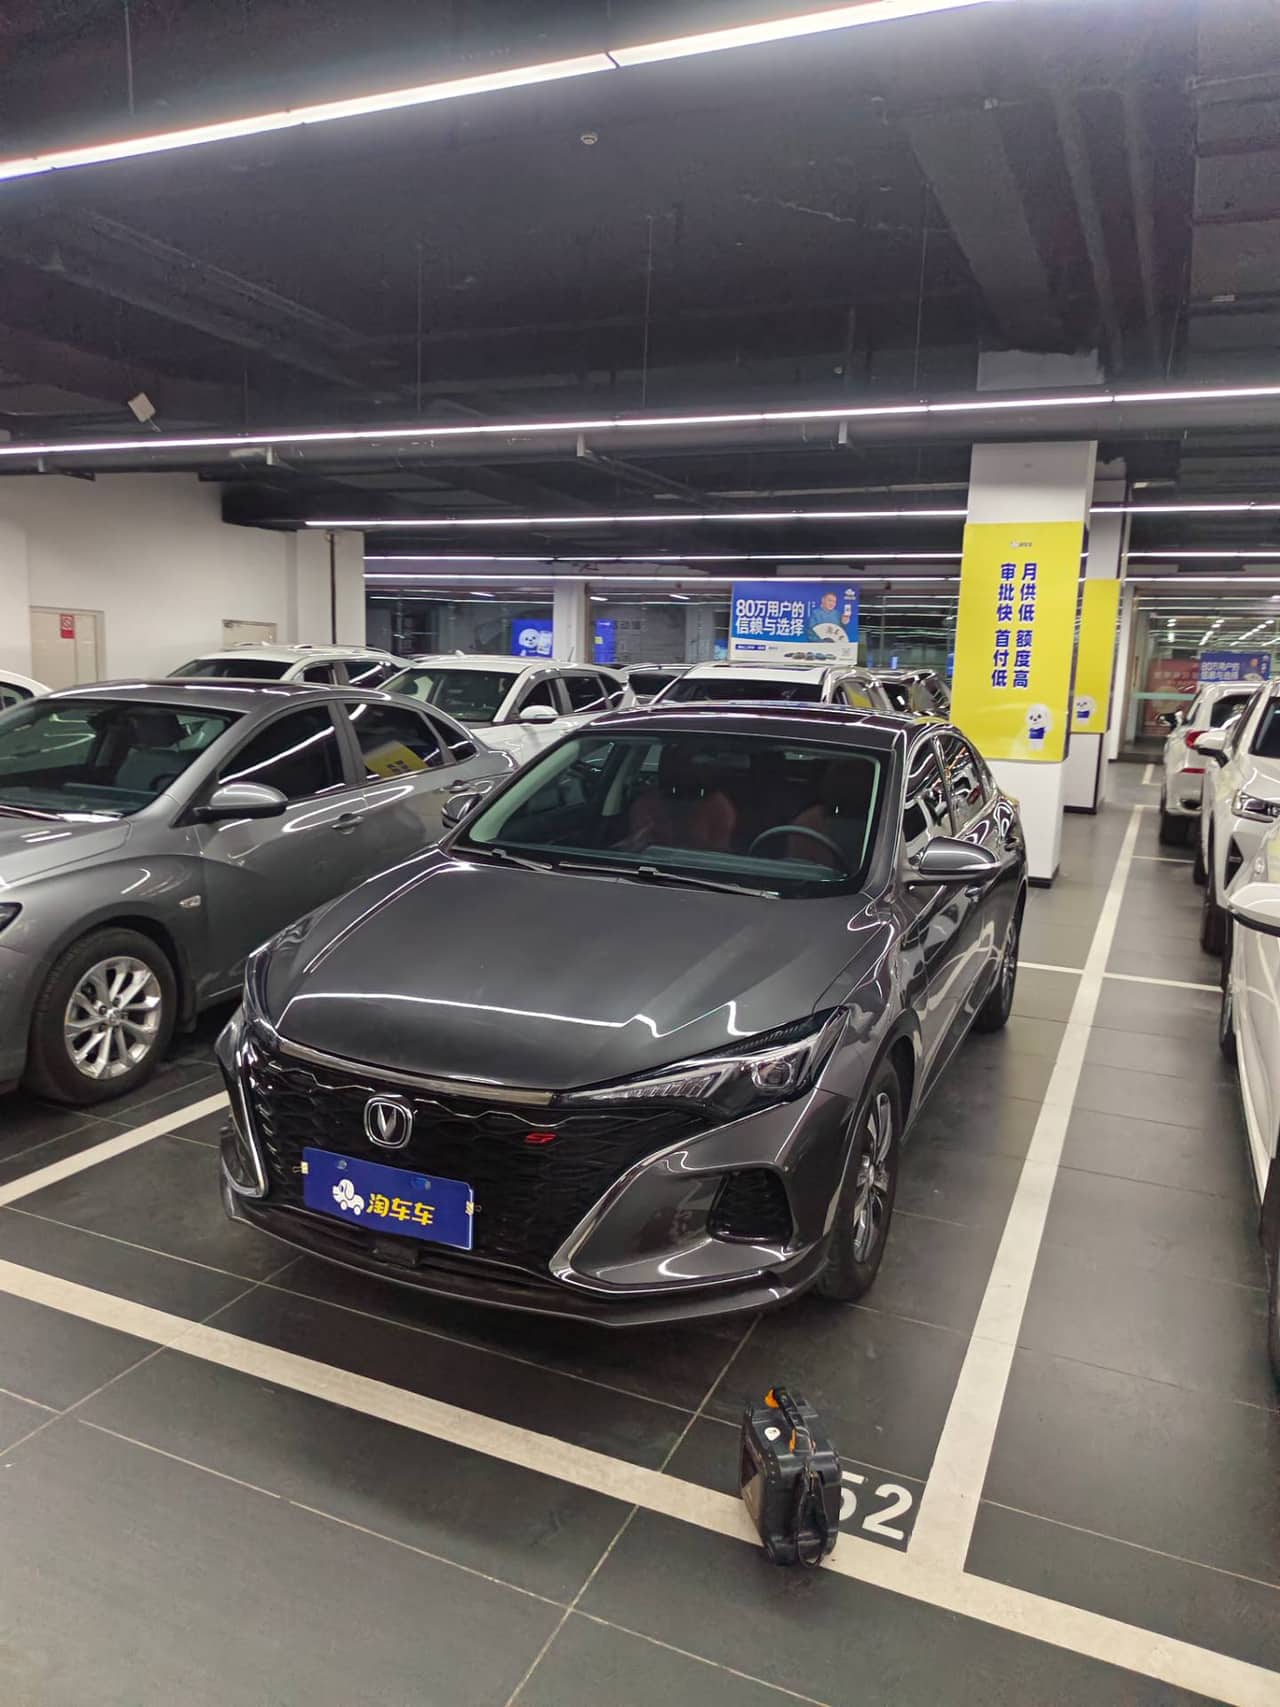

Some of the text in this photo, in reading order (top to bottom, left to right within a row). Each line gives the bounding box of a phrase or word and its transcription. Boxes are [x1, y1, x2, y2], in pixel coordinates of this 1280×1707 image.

[736, 599, 805, 618] 80万用户的
[1018, 563, 1037, 622] 月供低
[736, 618, 804, 637] 信赖与选择
[991, 563, 1016, 687] 审批快 首付低
[1013, 630, 1033, 688] 额度高
[366, 1193, 436, 1227] 淘车车
